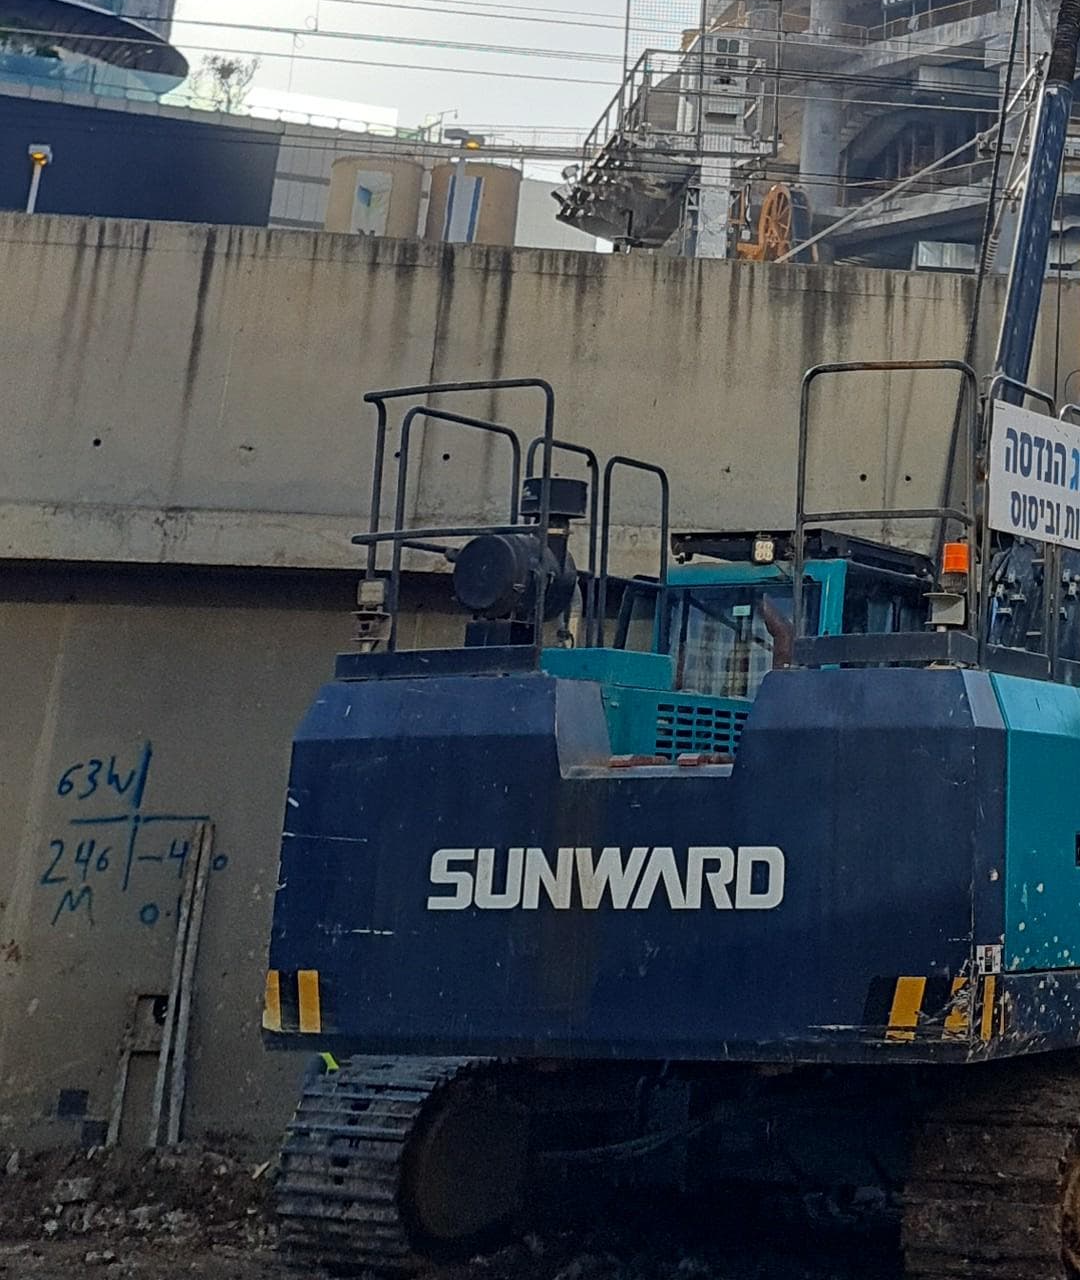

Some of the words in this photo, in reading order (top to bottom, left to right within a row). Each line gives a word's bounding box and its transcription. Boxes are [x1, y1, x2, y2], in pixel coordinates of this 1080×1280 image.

[1005, 427, 1067, 488] הנדסה
[1011, 491, 1060, 534] וביסוס
[427, 846, 785, 910] SUNWARD
